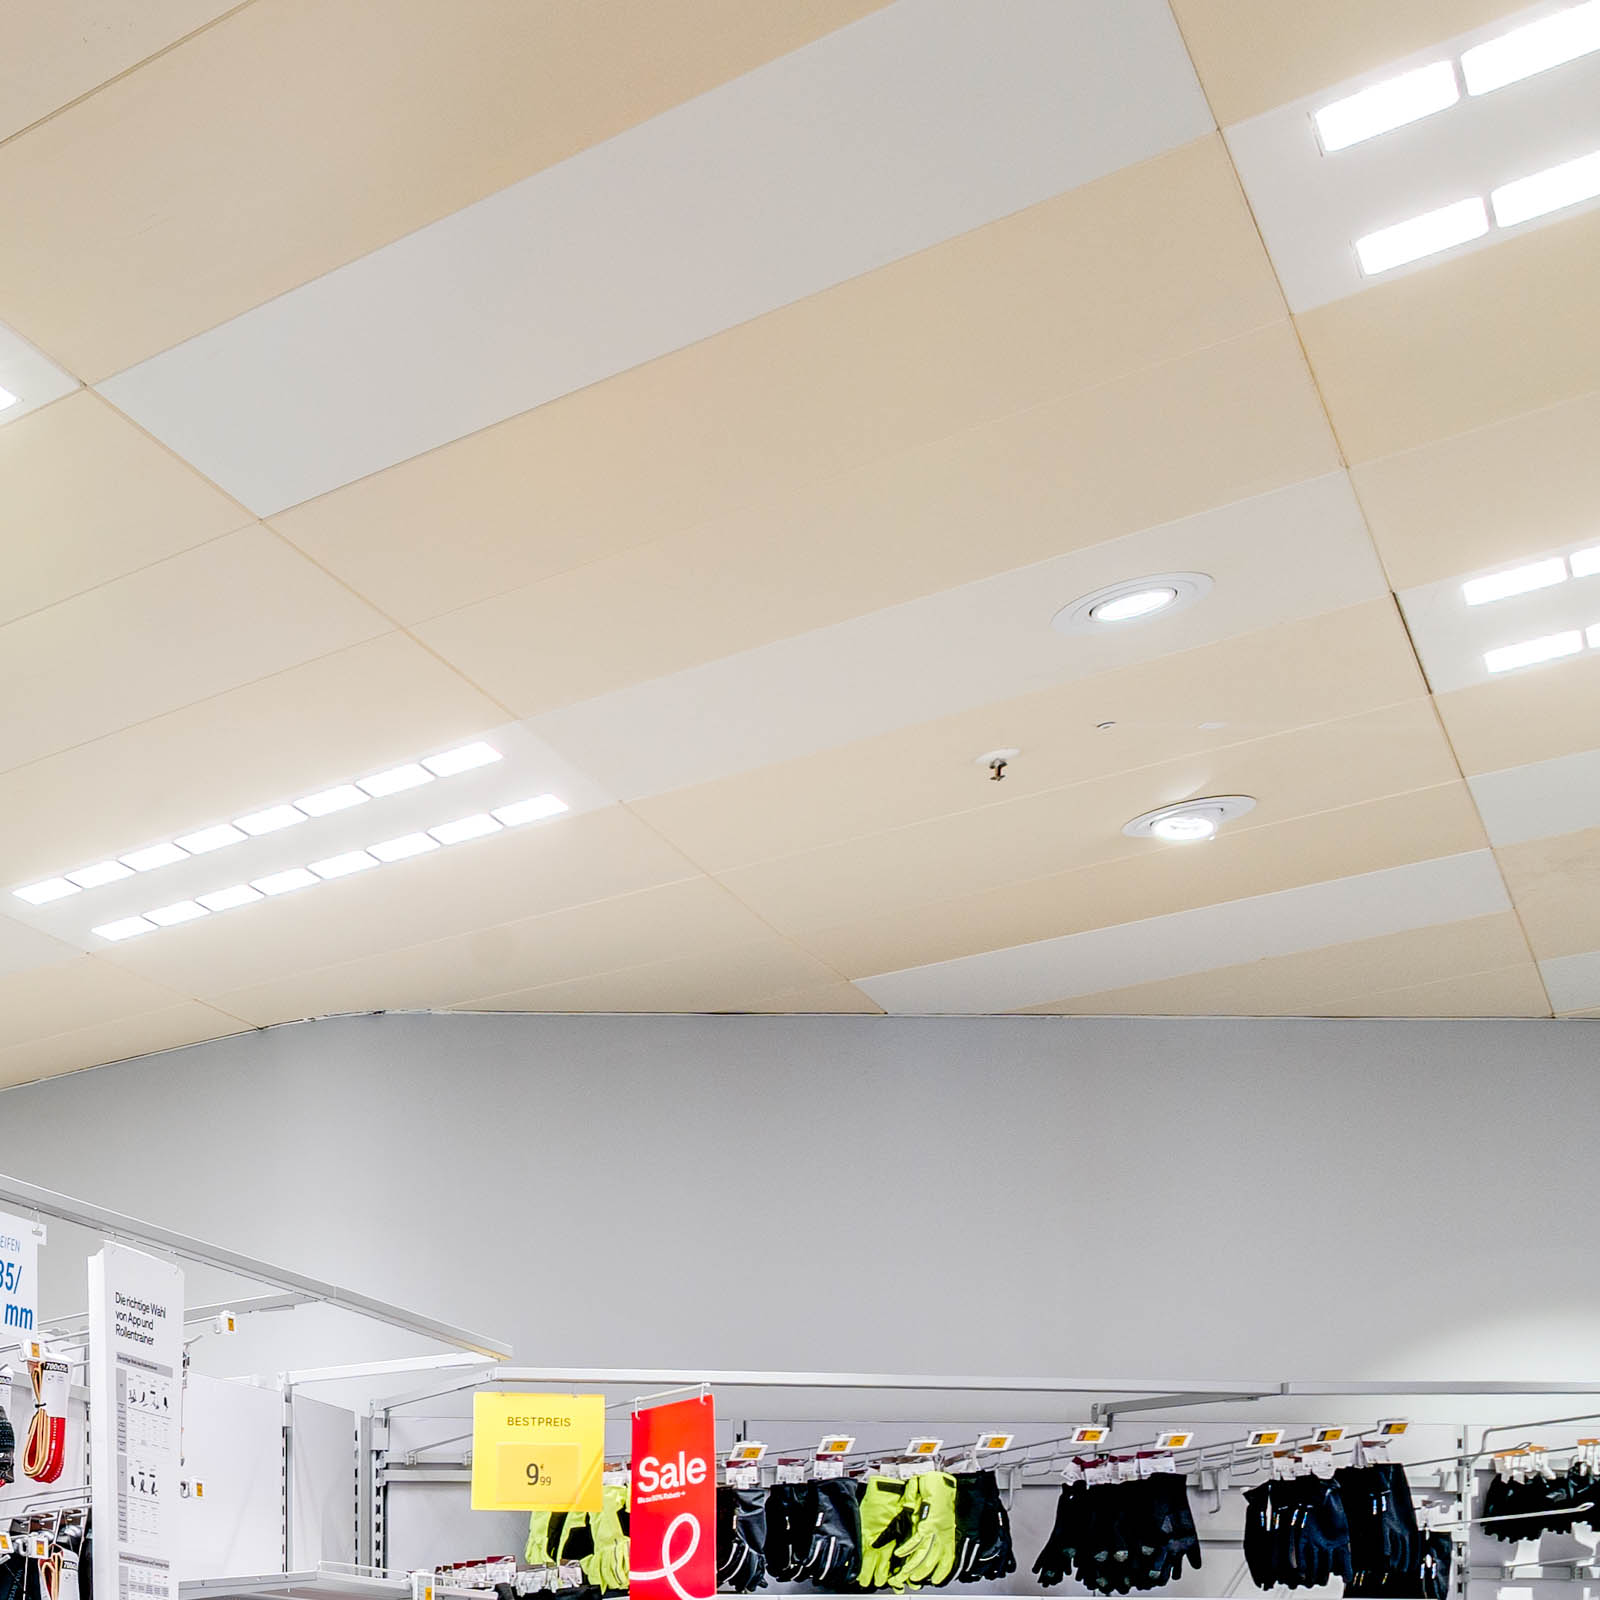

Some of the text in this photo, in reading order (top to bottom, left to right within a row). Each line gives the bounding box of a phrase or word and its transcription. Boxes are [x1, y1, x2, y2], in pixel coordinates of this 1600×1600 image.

[115, 1291, 166, 1319] Die richtige Wahl
[5, 1302, 33, 1331] mm
[115, 1310, 153, 1330] von App und
[115, 1326, 155, 1346] Rollentrainer
[506, 1416, 572, 1427] BESTPREIS
[525, 1463, 539, 1486] 9
[539, 1475, 552, 1486] 99
[638, 1450, 707, 1493] Sale
